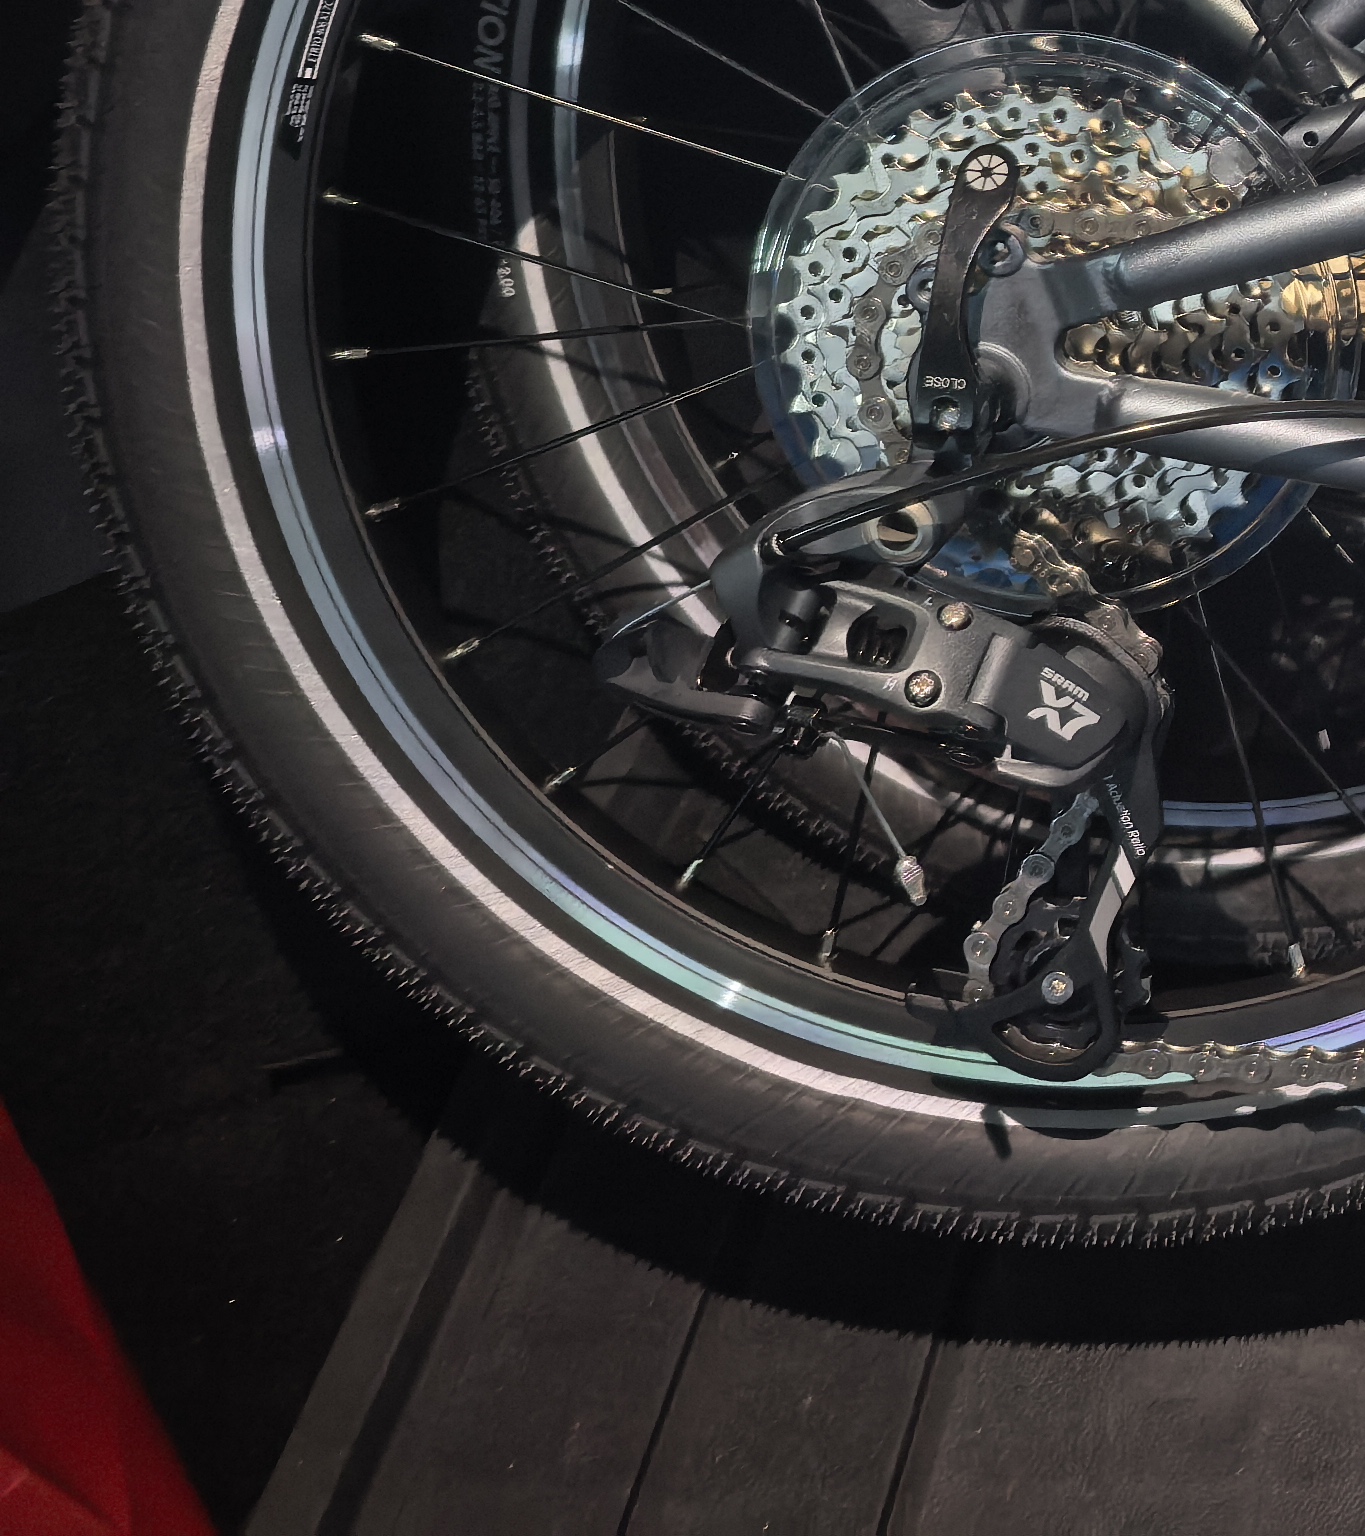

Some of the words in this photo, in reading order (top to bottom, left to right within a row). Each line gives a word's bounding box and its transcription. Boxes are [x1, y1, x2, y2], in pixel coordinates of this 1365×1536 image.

[922, 374, 968, 390] CLOSE
[1040, 666, 1090, 702] SRAM
[1126, 829, 1147, 856] Ratio
